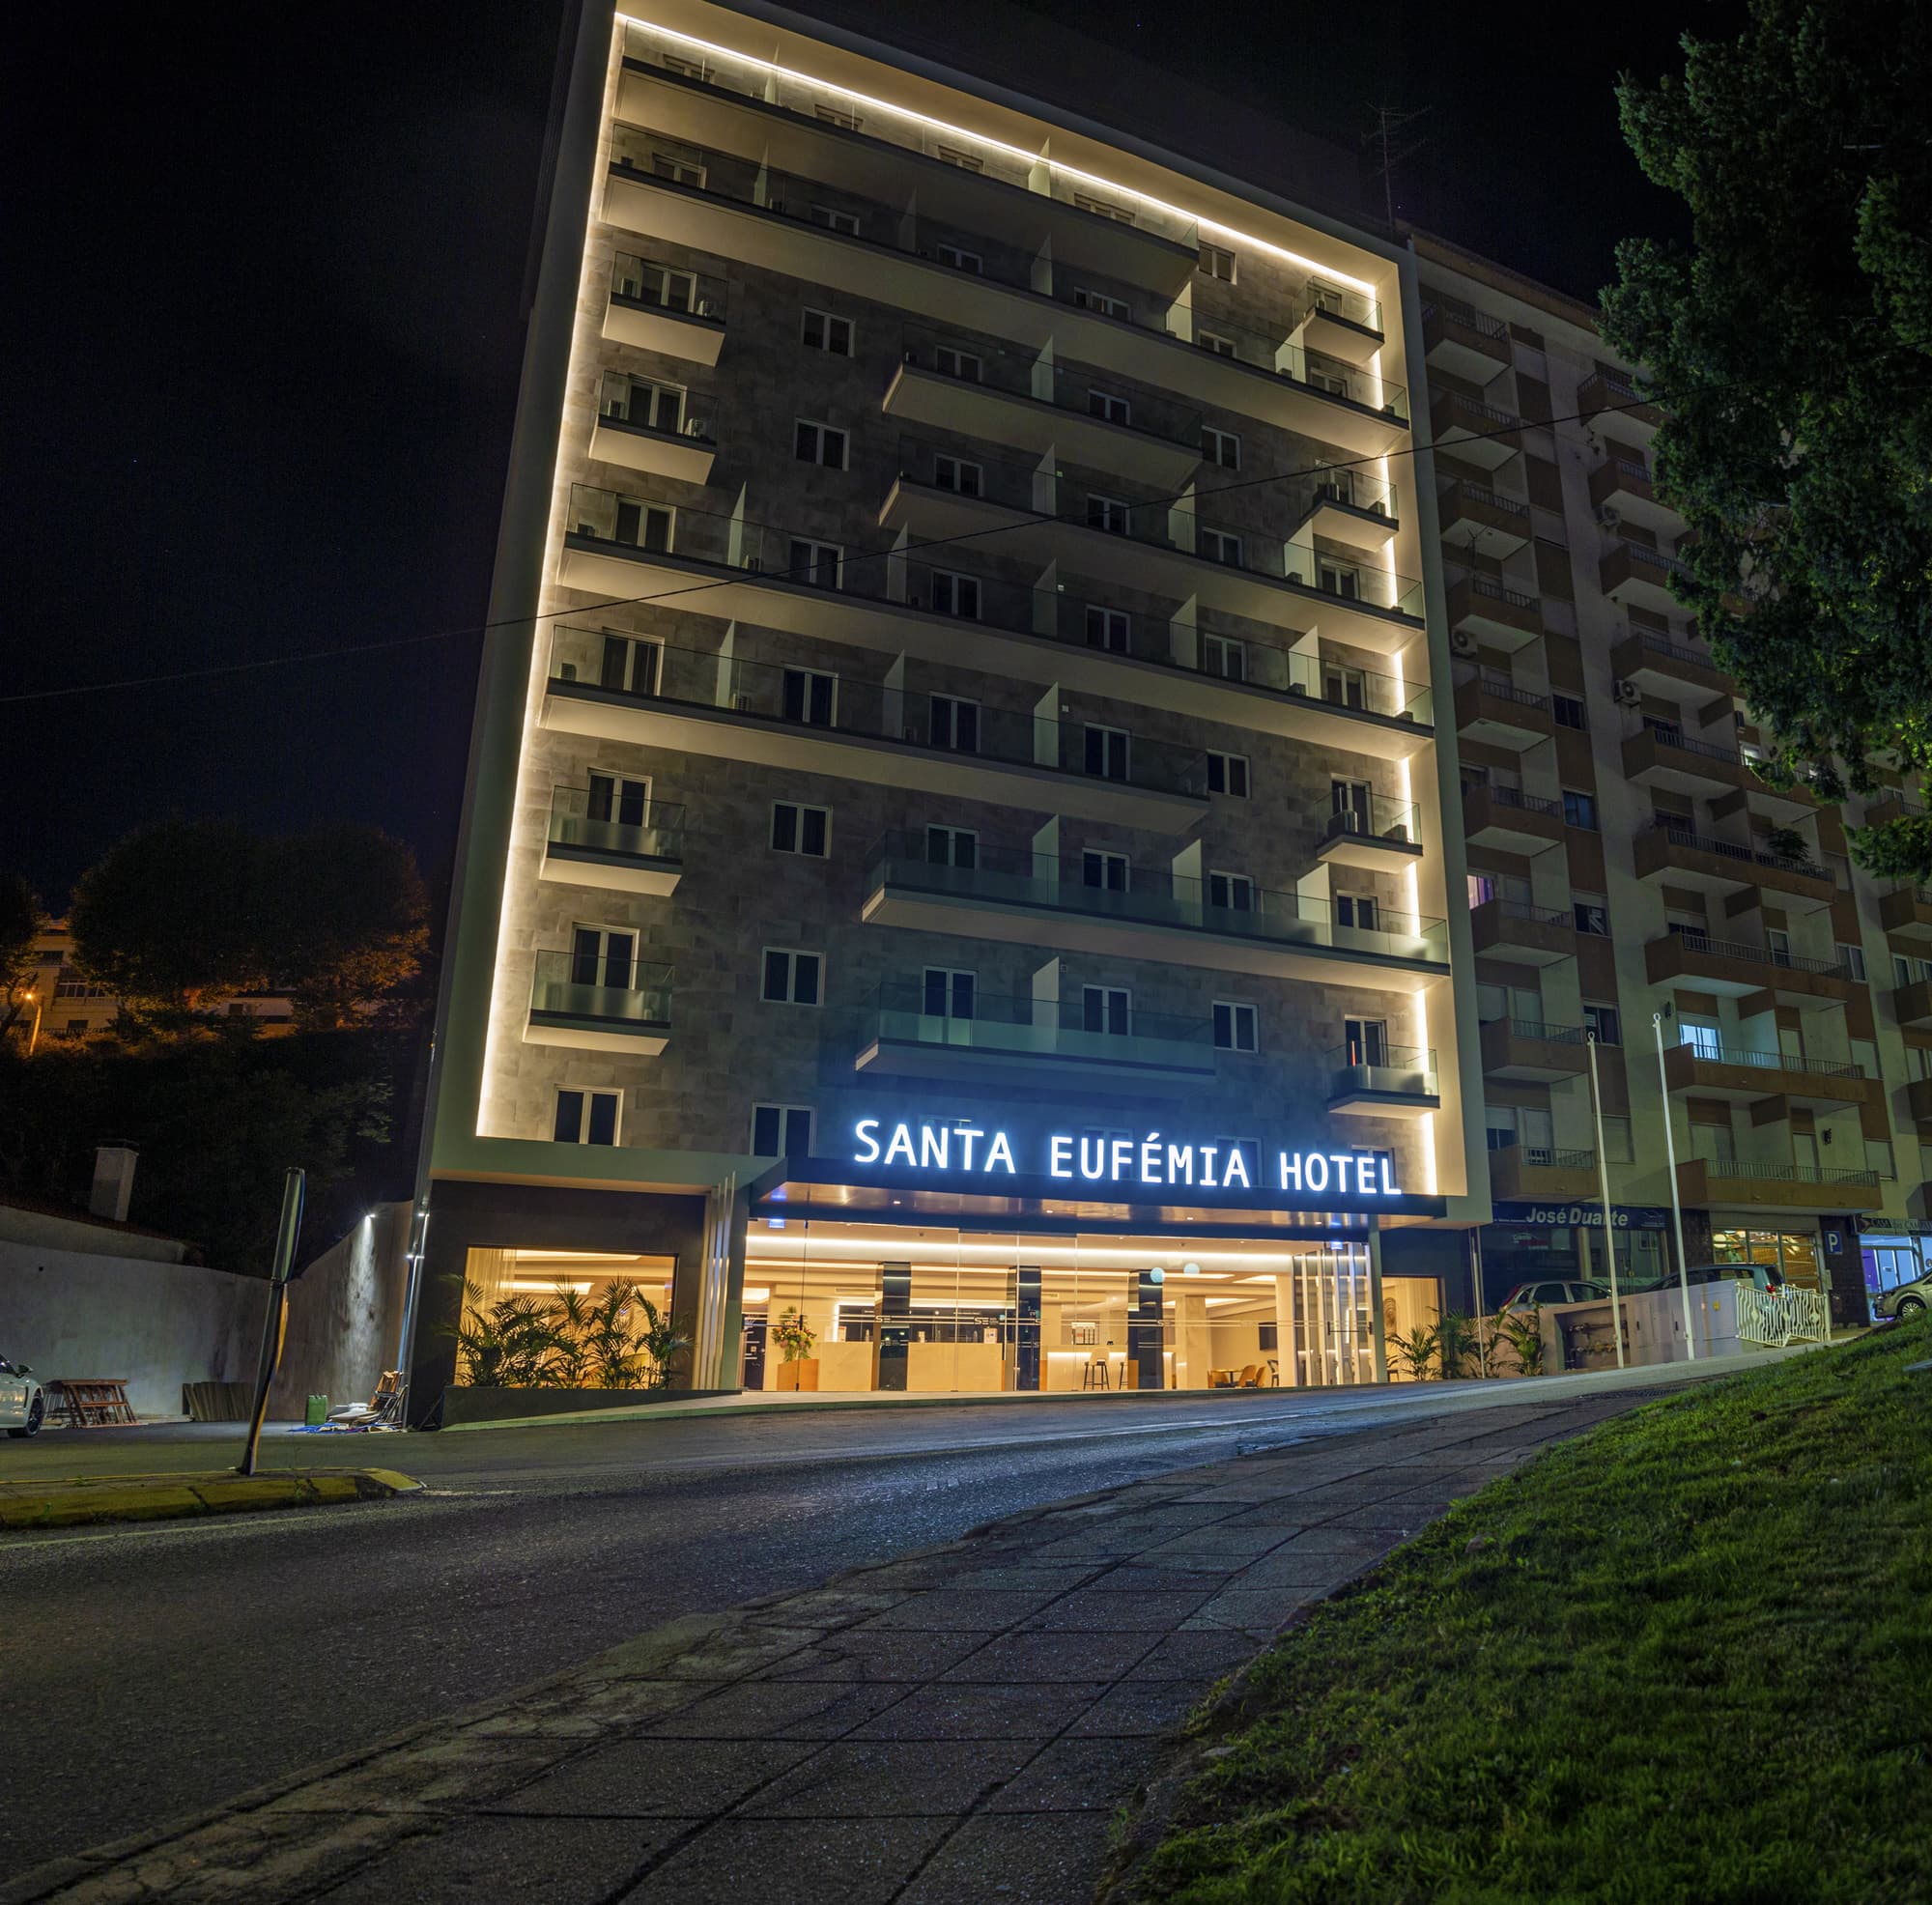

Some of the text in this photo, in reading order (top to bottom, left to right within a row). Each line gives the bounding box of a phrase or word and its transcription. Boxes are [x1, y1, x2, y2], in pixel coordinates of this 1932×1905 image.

[854, 1119, 1403, 1196] SANTA EUFÉMIA HOTEL
[1526, 1208, 1567, 1224] José
[1828, 1233, 1838, 1252] P
